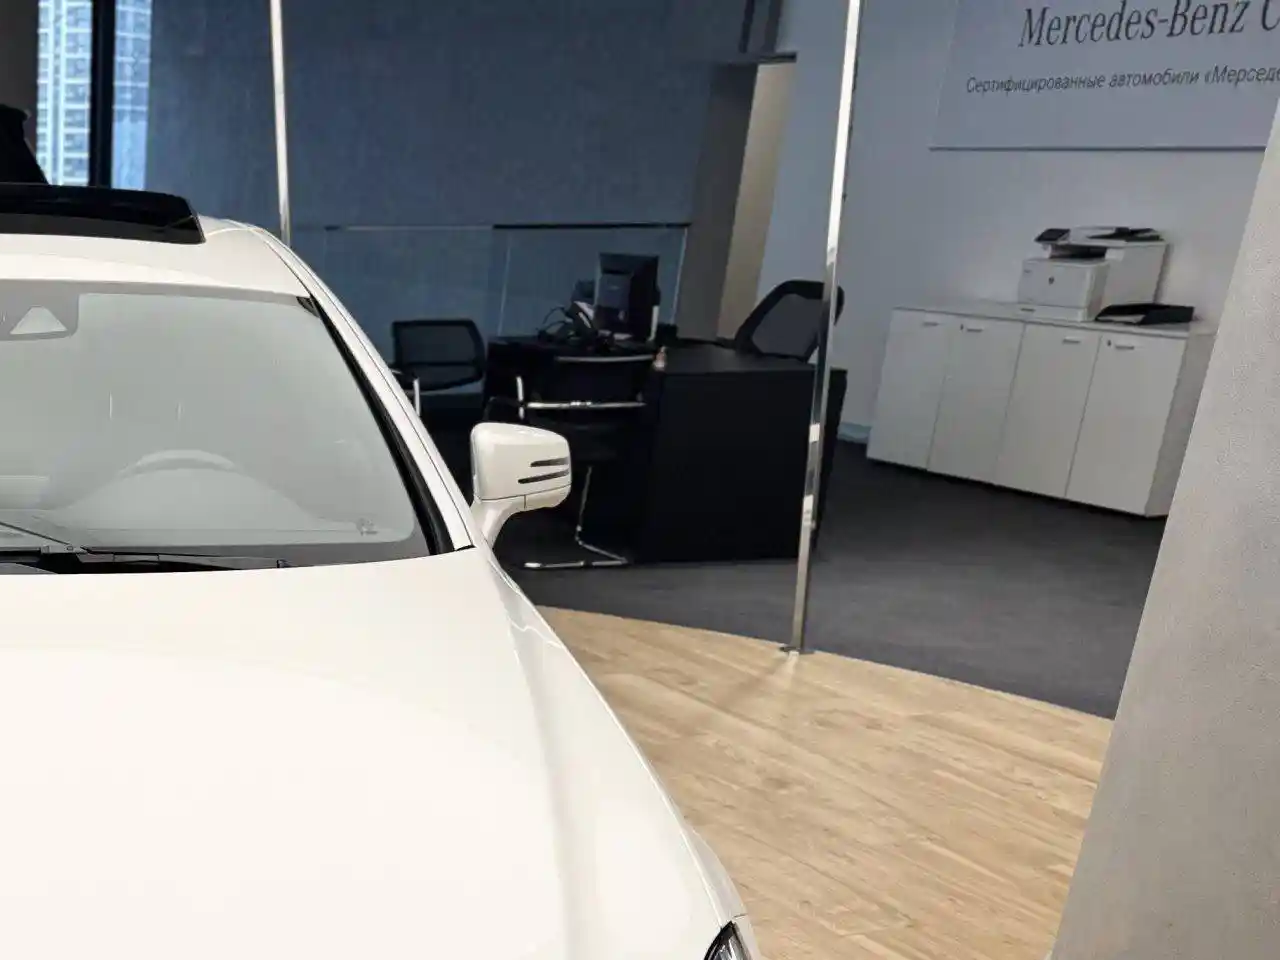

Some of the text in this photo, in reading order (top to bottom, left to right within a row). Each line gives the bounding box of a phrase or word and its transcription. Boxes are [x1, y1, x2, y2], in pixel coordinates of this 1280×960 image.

[1018, 0, 1250, 47] Mercedes-Benz
[966, 74, 1106, 97] Сертифицированные
[1108, 68, 1200, 88] автомобили
